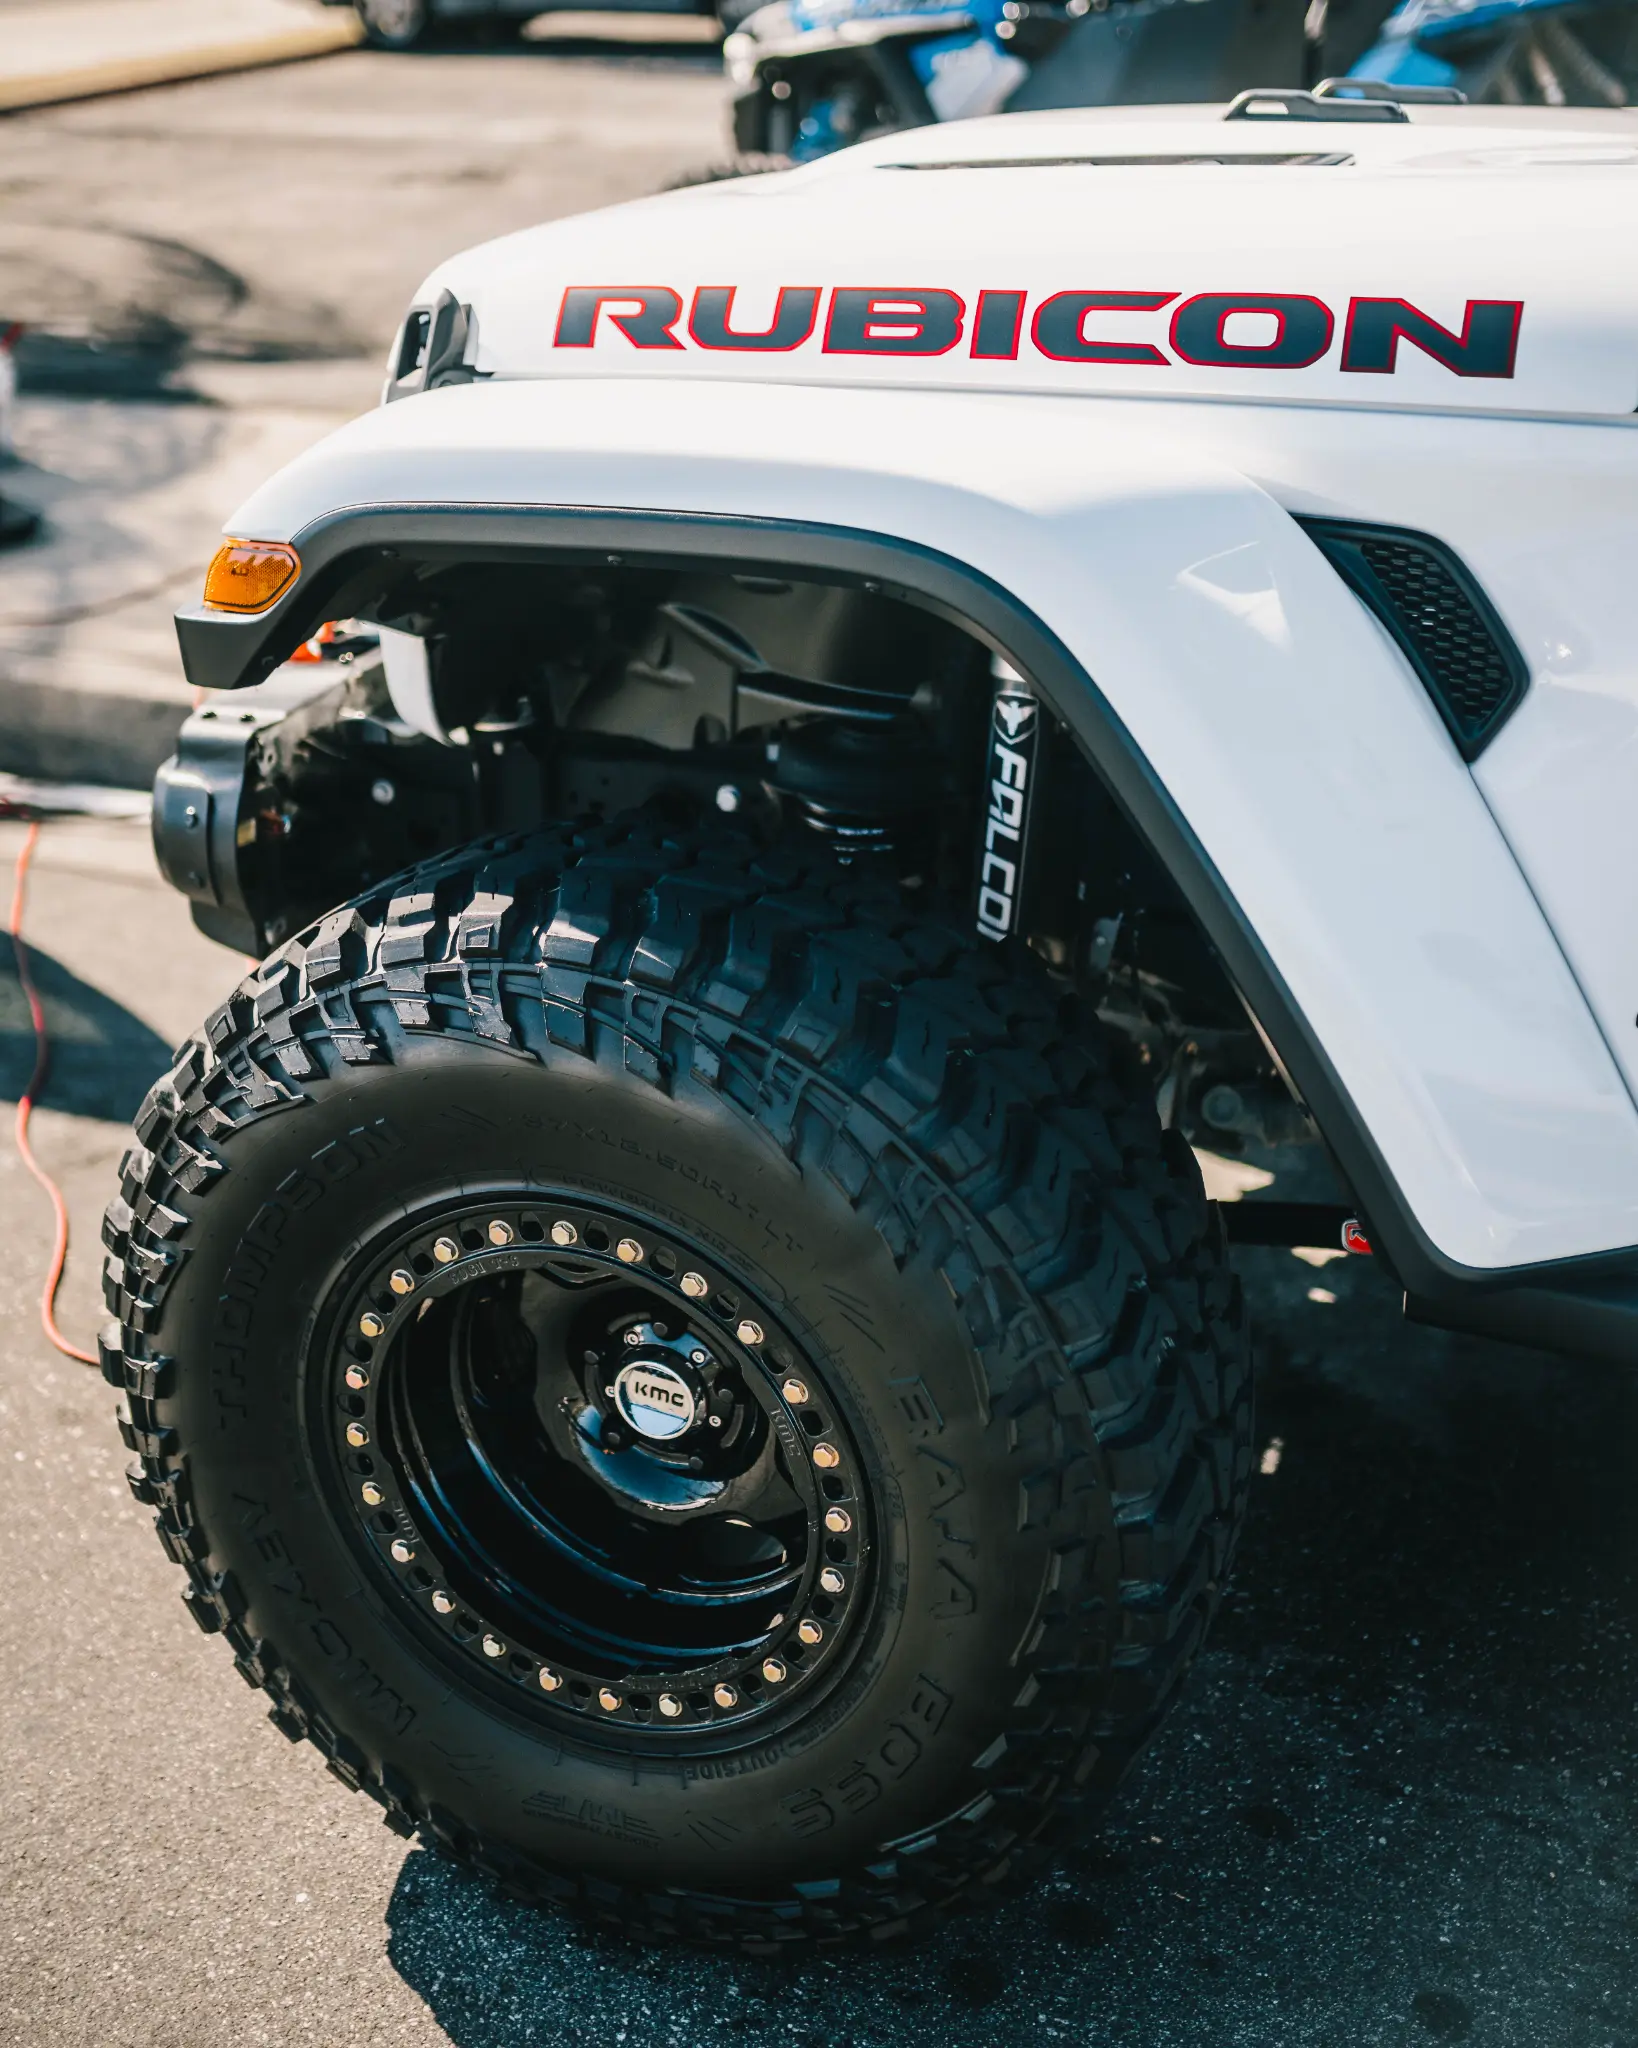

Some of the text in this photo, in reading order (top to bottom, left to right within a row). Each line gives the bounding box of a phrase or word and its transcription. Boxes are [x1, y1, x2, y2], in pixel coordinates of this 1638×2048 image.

[553, 285, 1524, 379] RUBICON
[211, 1117, 417, 1737] MICKEY THOMPSON
[889, 1375, 979, 1620] BAJA
[684, 1749, 779, 1780] OUTSIDE
[788, 1672, 953, 1838] BOSS
